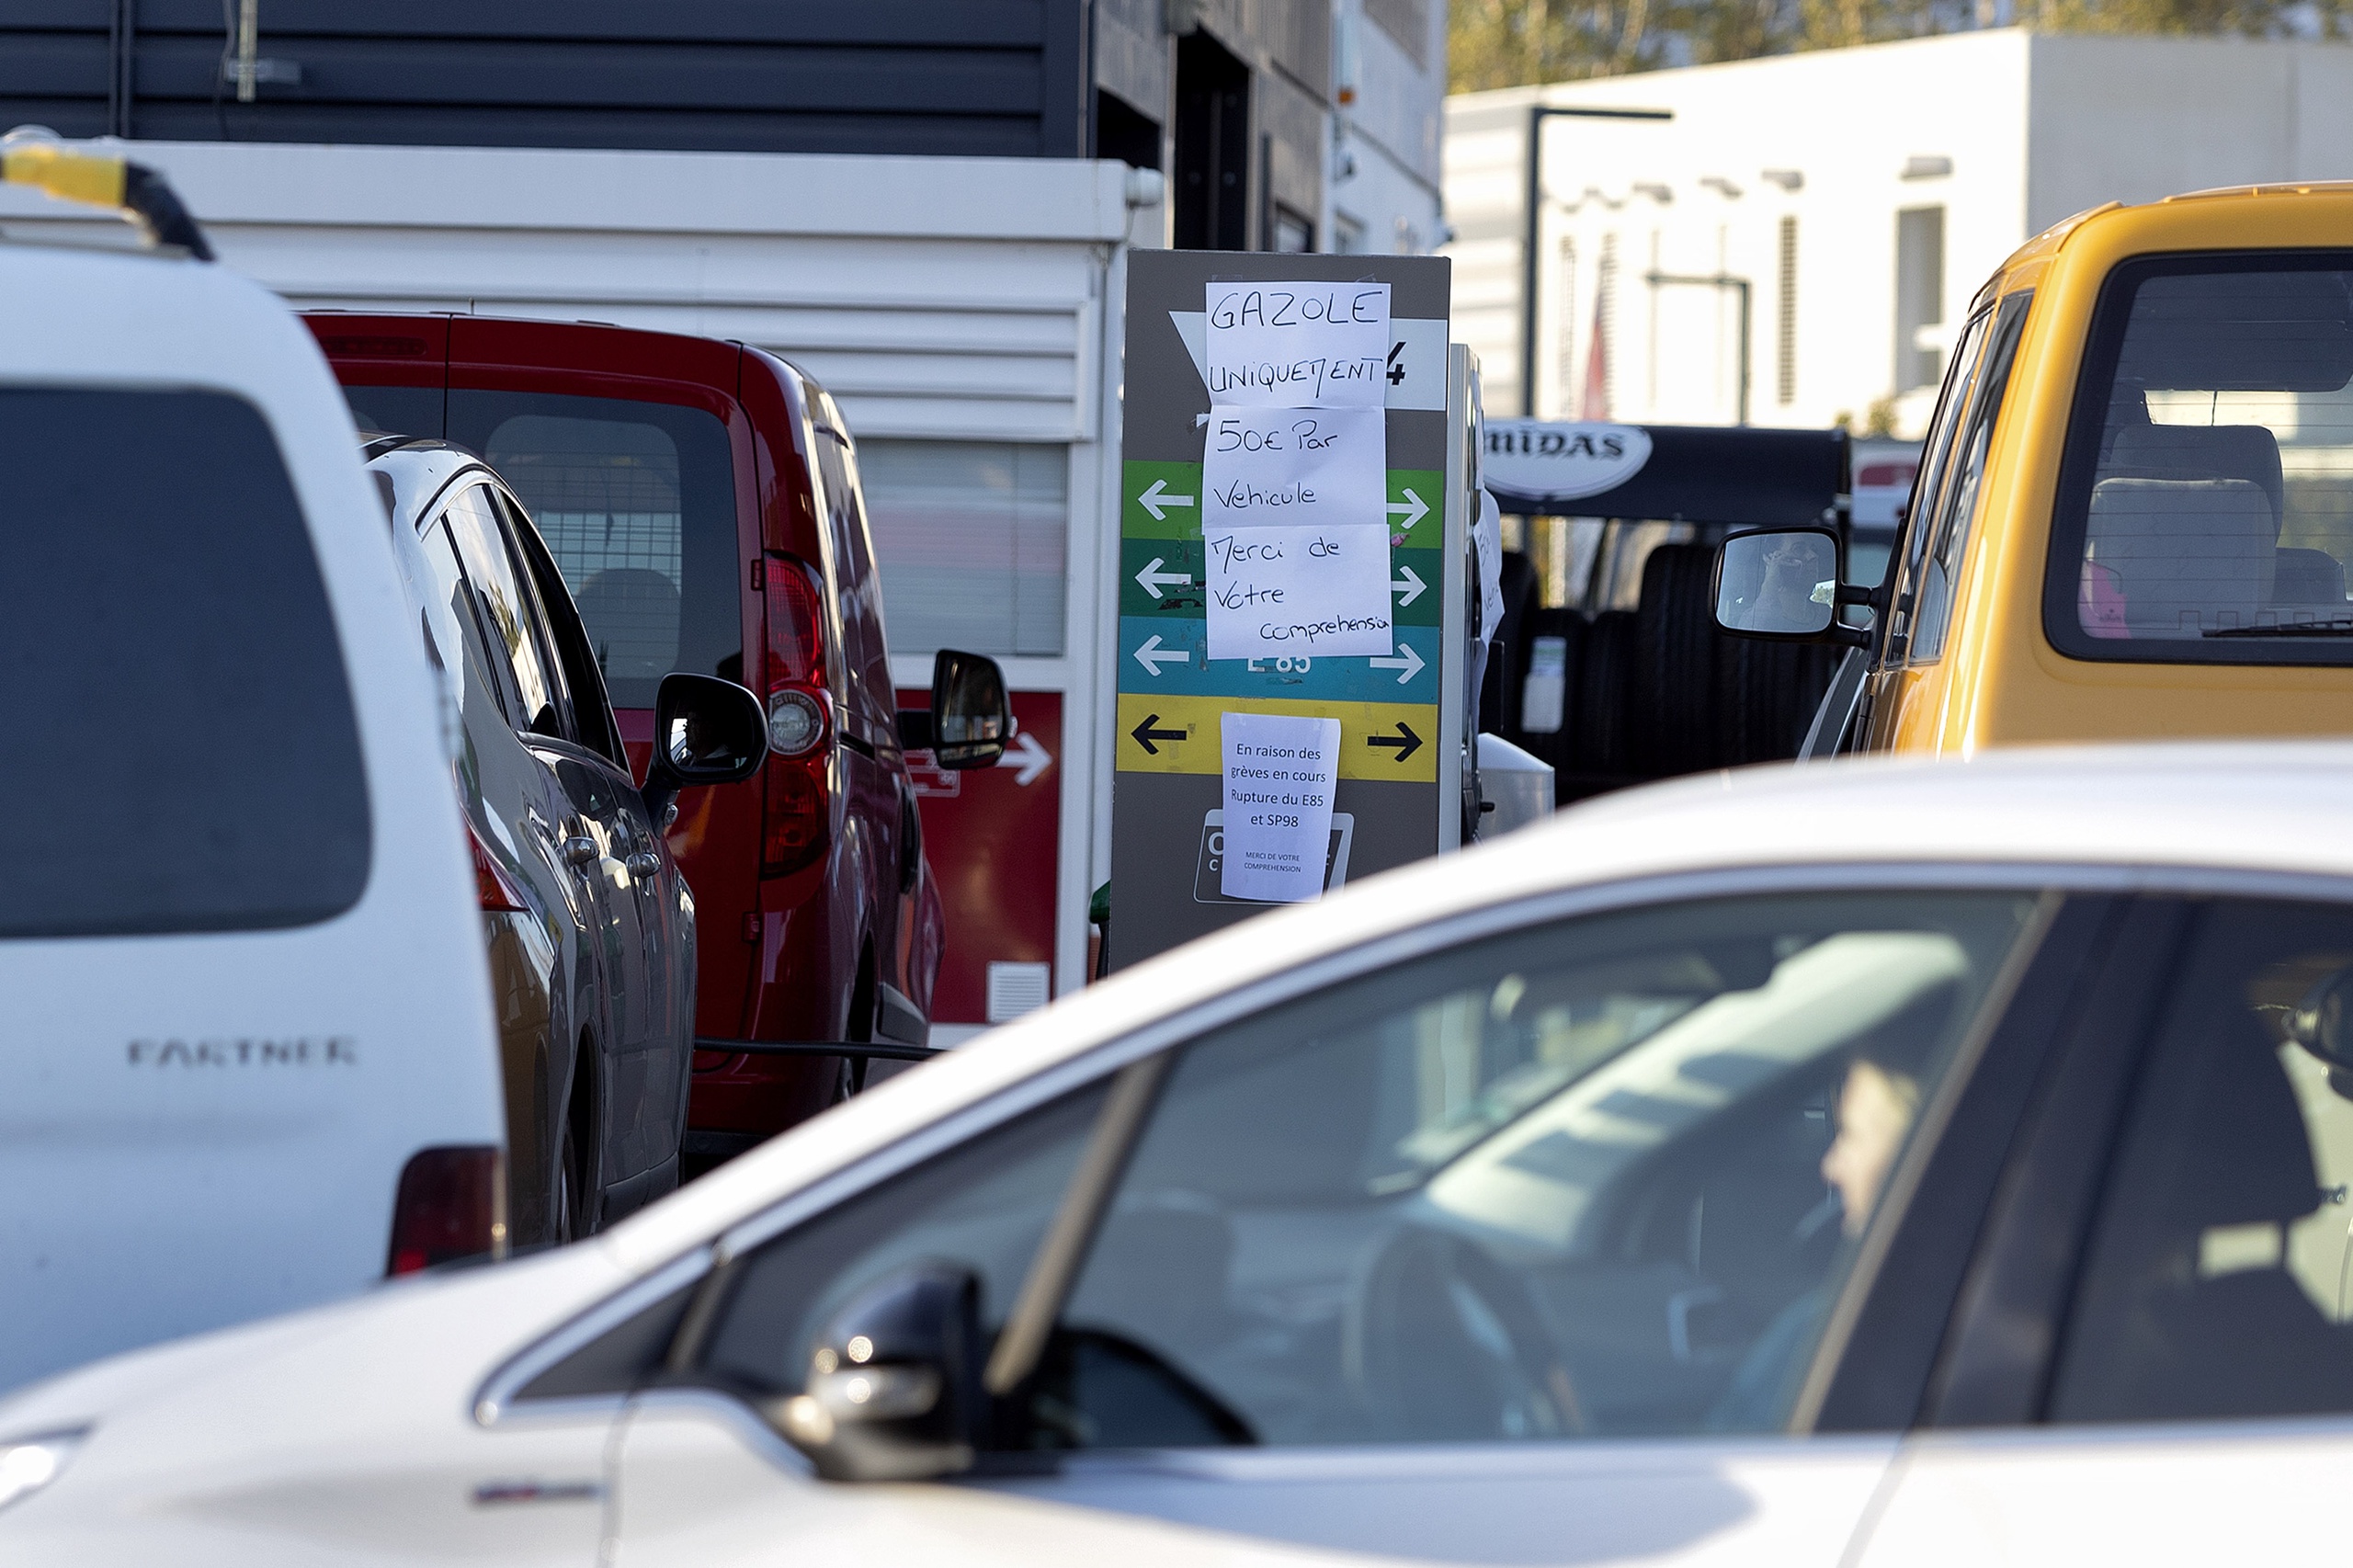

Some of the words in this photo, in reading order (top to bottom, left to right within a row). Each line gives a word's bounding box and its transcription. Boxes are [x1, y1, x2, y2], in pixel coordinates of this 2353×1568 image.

[1211, 290, 1383, 330] GAZOLE
[1217, 419, 1283, 452] 50€
[1291, 419, 1338, 450] Par
[1213, 479, 1316, 508] Vehicule
[1211, 535, 1283, 574] Merci
[1308, 536, 1340, 557] de
[1213, 580, 1284, 609] Votre
[1236, 743, 1252, 756] En
[1256, 745, 1295, 758] raison
[1299, 747, 1321, 760] des
[1231, 765, 1269, 779] grèves
[1272, 770, 1289, 780] en
[1292, 771, 1326, 783] cours
[1231, 789, 1279, 804] Rupture
[1281, 793, 1299, 805] du
[1302, 794, 1324, 807] E85
[1250, 814, 1264, 825] et
[1267, 814, 1299, 828] SP98
[1244, 862, 1302, 873] COMPREHENSION
[1245, 851, 1267, 859] MERCI
[1278, 854, 1301, 862] VOTRE
[126, 1036, 358, 1068] PARTNER
